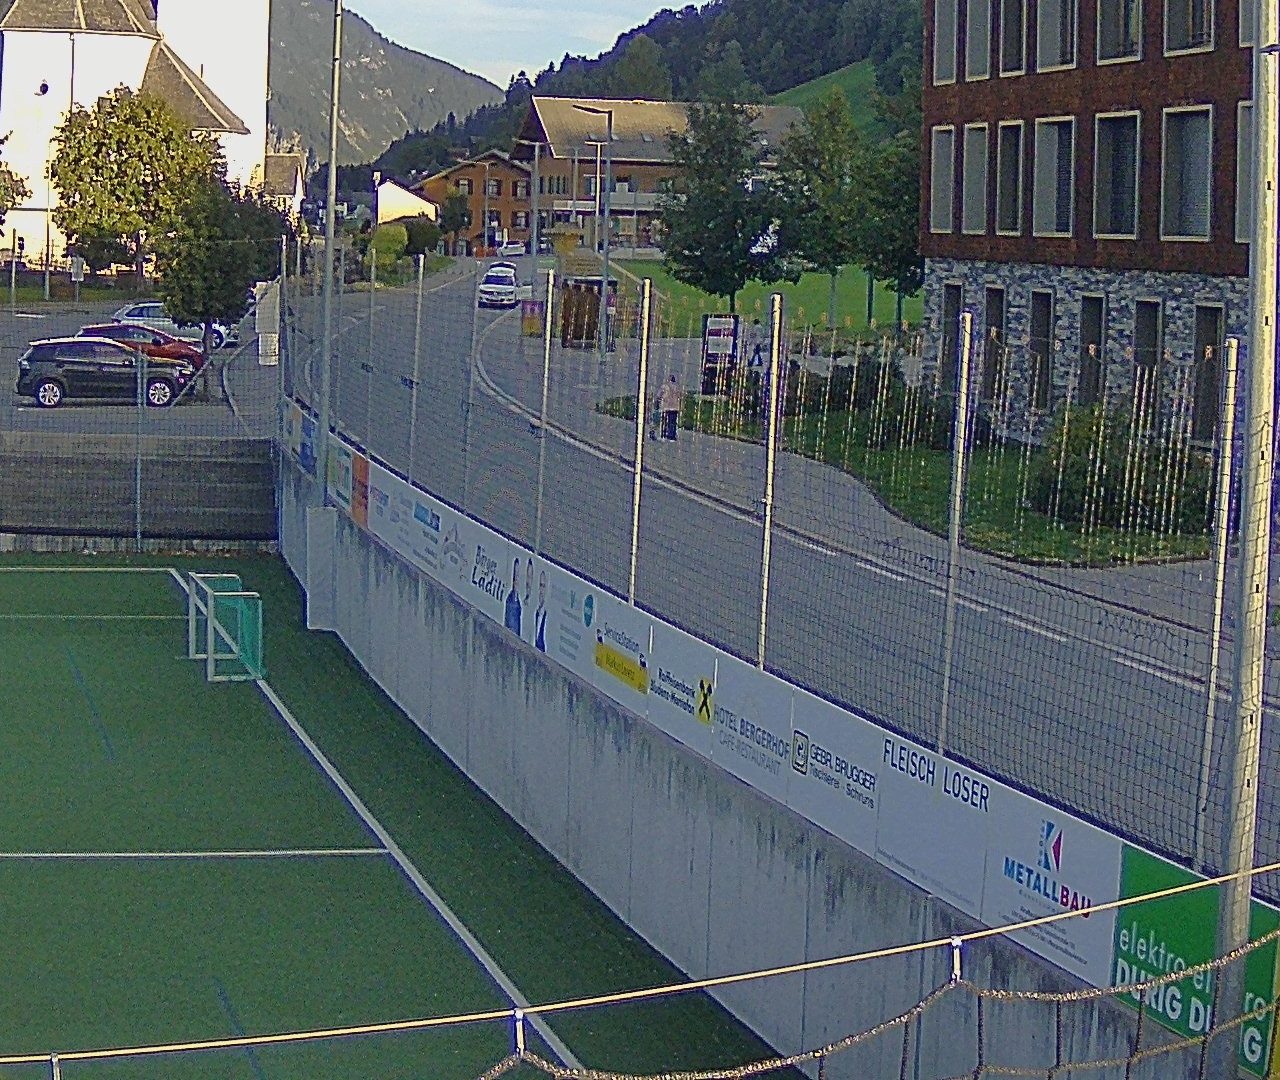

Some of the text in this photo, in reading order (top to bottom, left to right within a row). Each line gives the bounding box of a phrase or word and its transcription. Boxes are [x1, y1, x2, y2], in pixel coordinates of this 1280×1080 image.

[713, 704, 790, 760] HOTEL BERGERHOF
[883, 738, 990, 812] FLEISCH LOSER
[1003, 855, 1092, 919] METALLBAU
